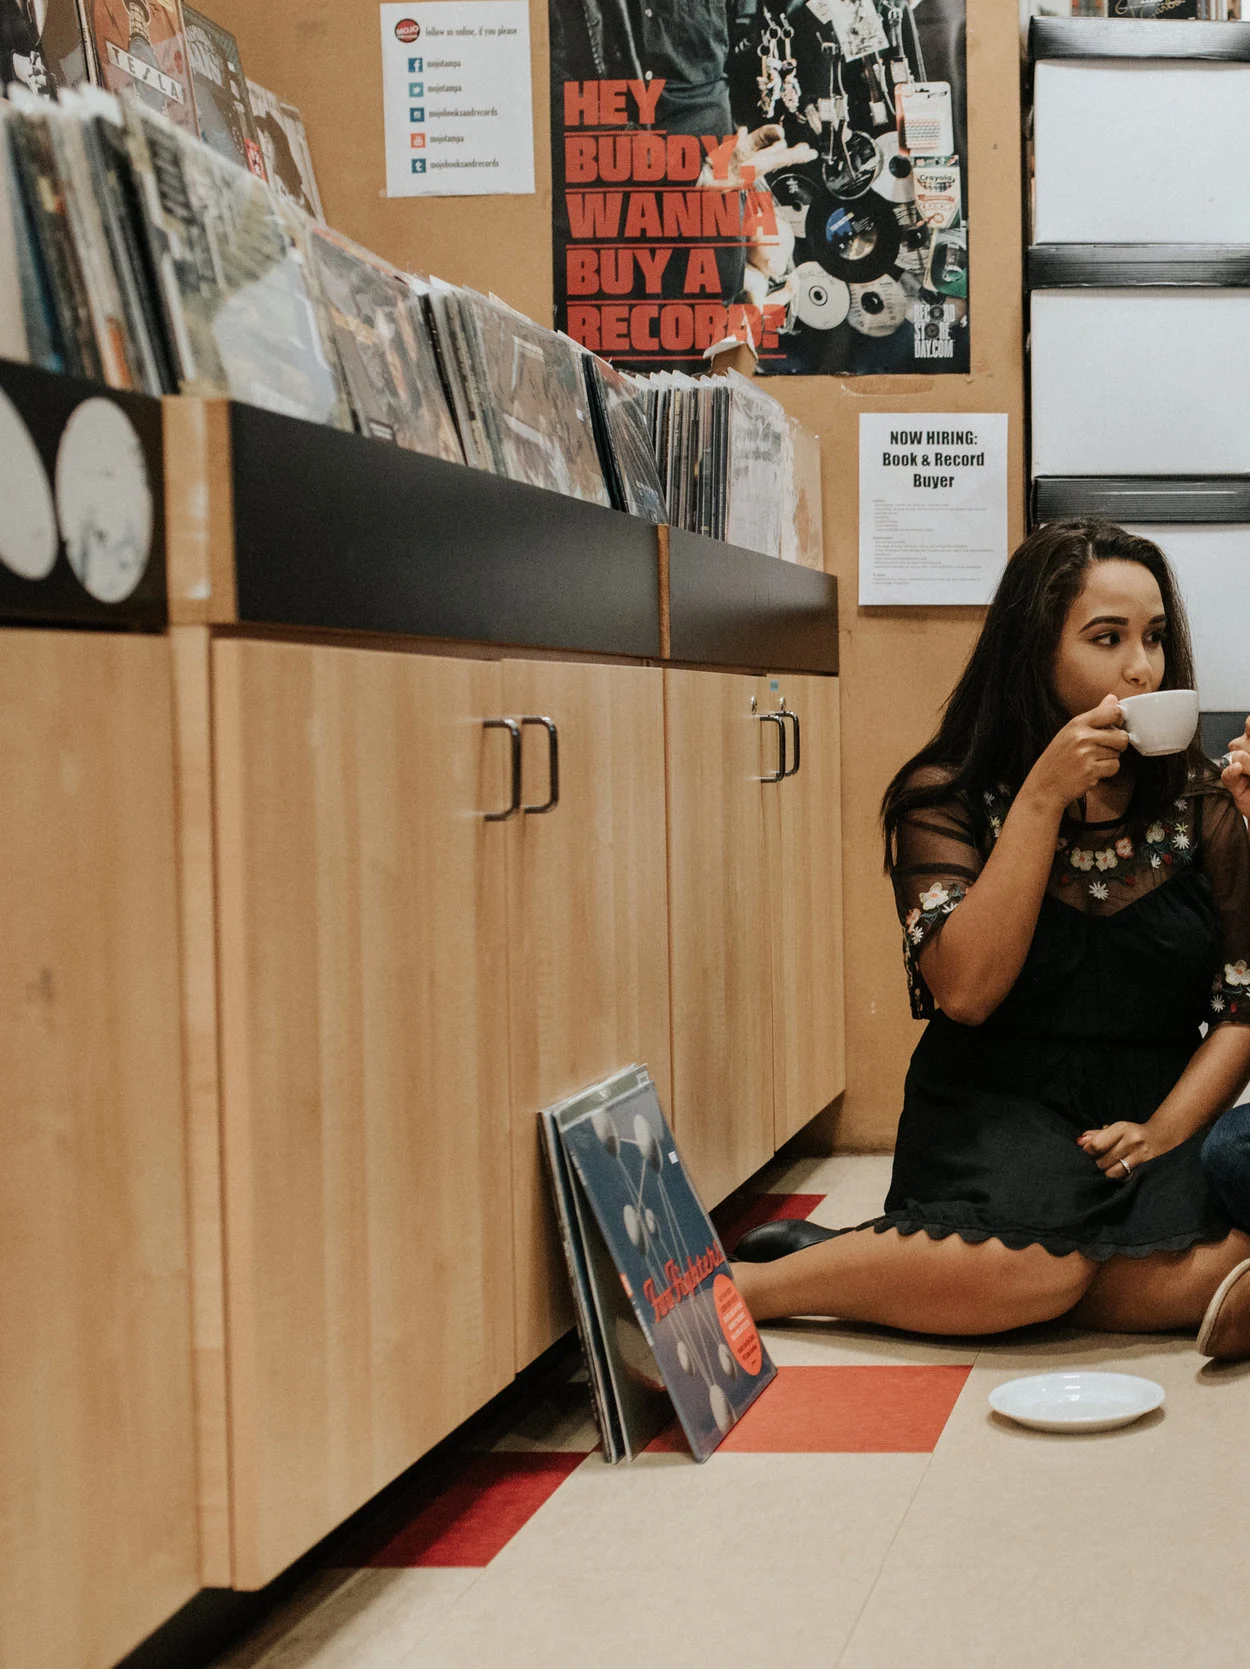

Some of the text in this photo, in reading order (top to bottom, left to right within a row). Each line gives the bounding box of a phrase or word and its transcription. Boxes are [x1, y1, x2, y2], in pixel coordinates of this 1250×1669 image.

[425, 26, 445, 37] follow
[497, 25, 518, 37] please
[427, 58, 461, 69] mojotampa
[108, 44, 180, 100] TESLA
[427, 83, 462, 94] mojotampa
[564, 79, 666, 126] HEY
[429, 106, 498, 118] mojobooksandrecords
[430, 134, 465, 144] mojotampa
[430, 157, 500, 170] mojobooksandrecords
[564, 135, 756, 191] BUDDY,
[919, 174, 954, 184] Crayola
[565, 191, 778, 238] WANNA
[566, 248, 722, 296] BUY A
[567, 304, 787, 351] RECORD?
[890, 430, 978, 446] NOW HIRING:
[882, 452, 985, 467] Book & Record
[913, 473, 955, 490] Buyer
[643, 1239, 727, 1323] Foo Fighters
